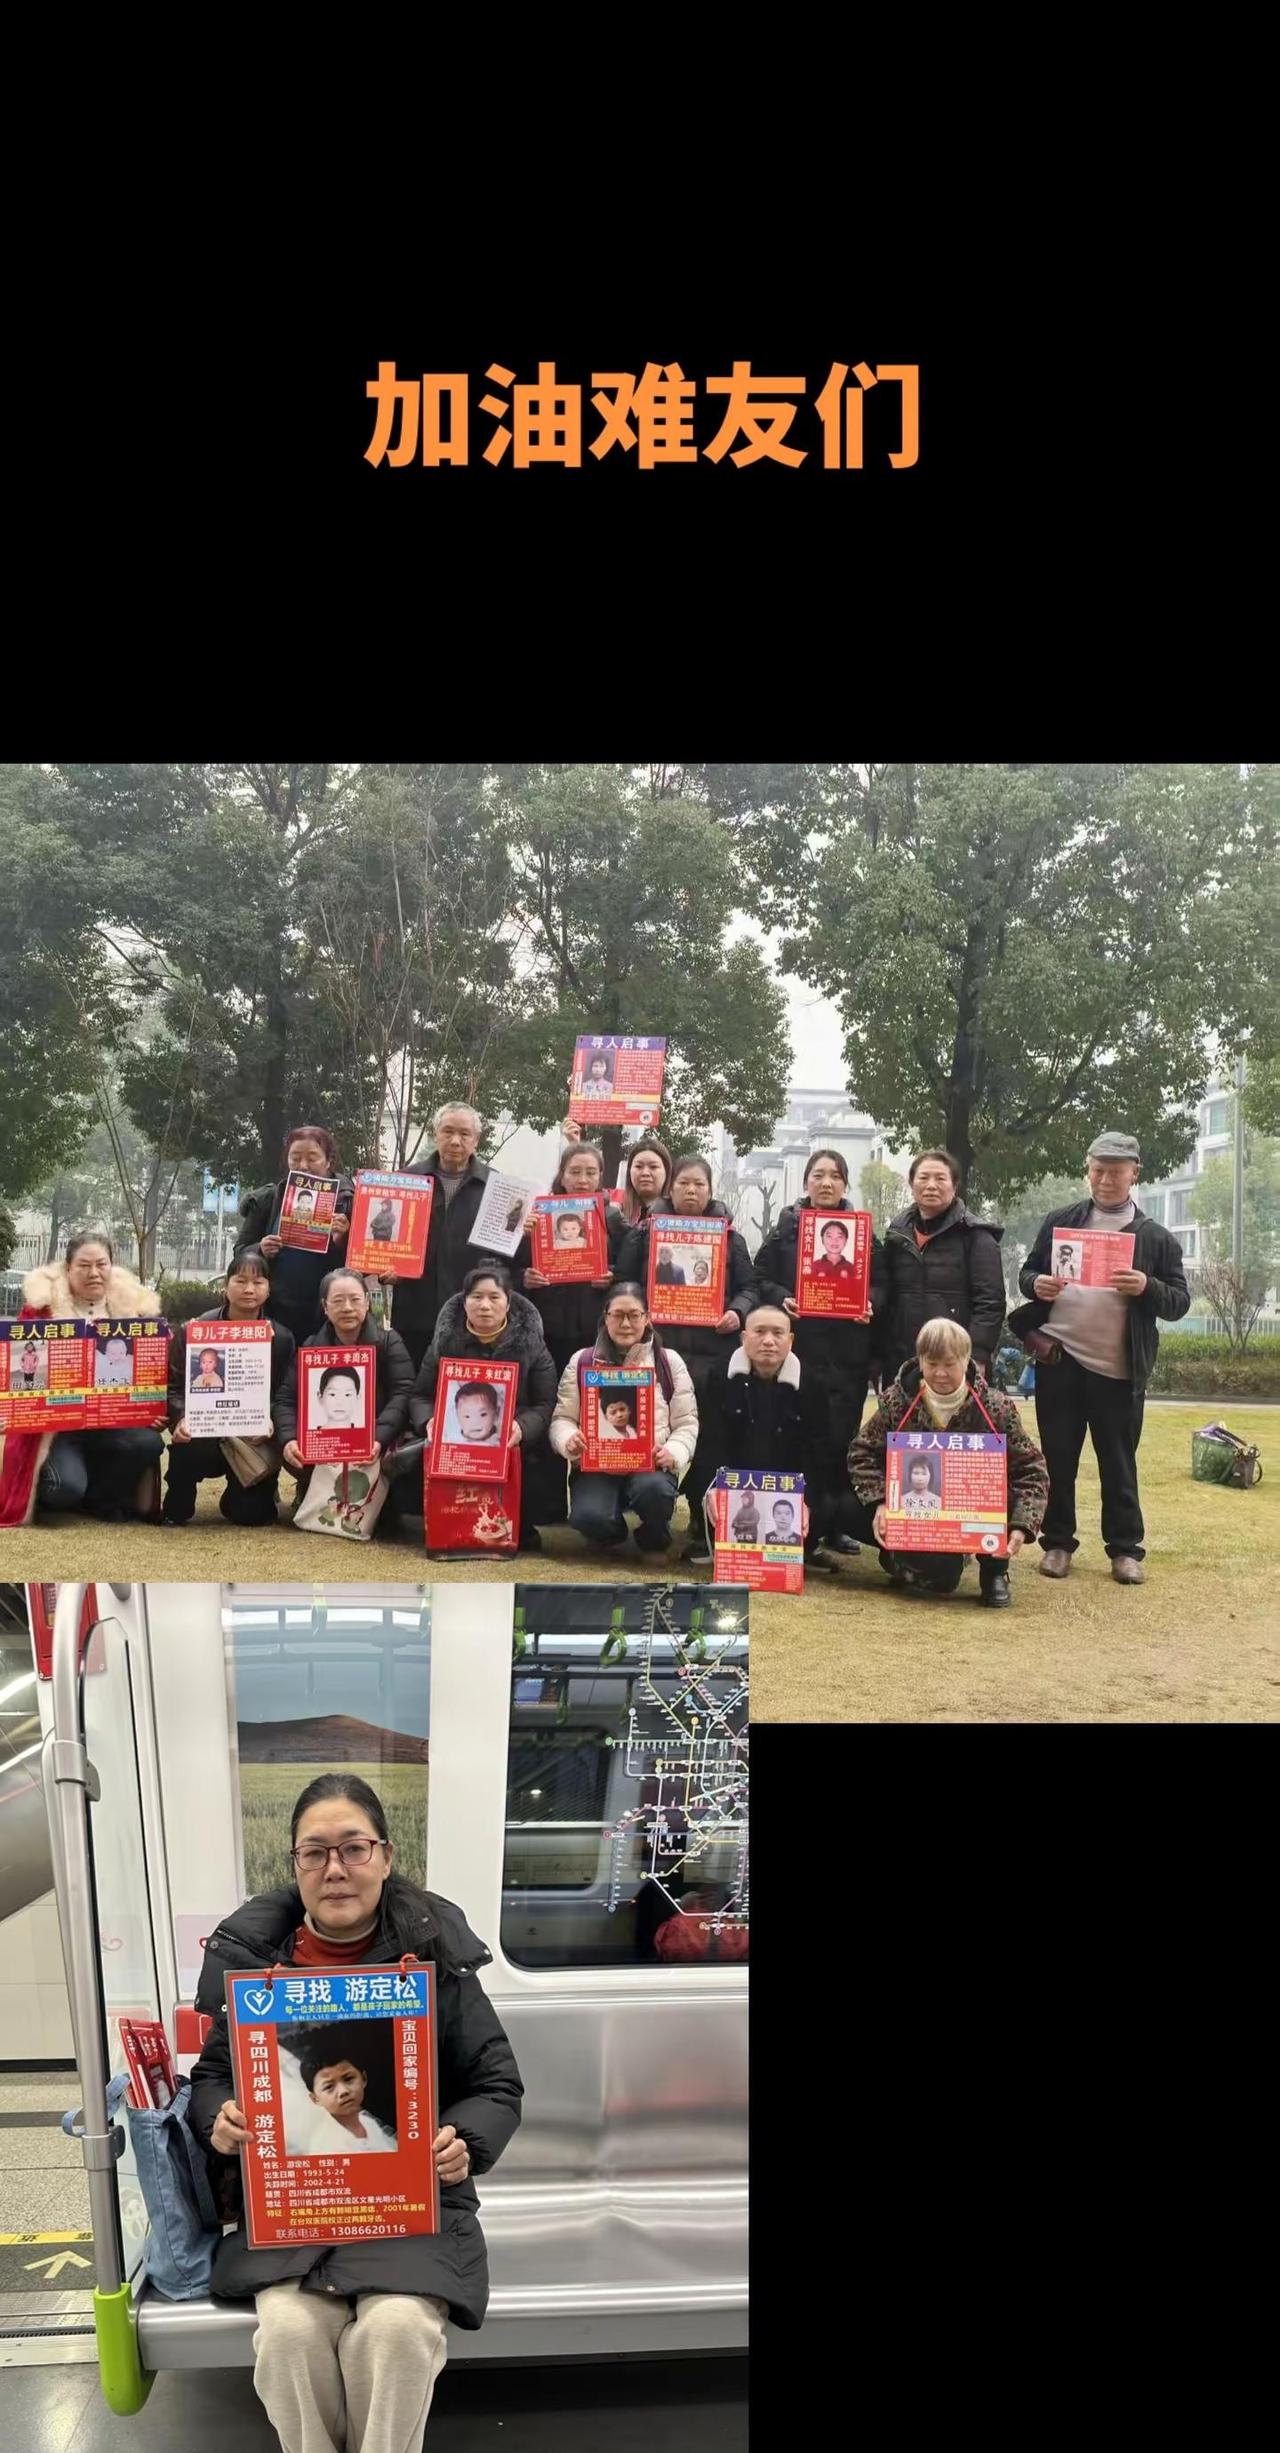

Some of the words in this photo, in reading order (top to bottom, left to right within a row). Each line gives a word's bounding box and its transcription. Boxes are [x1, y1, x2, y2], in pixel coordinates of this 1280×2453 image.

[592, 1037, 649, 1050] 寻人启事
[295, 1176, 332, 1191] 寻人启事
[803, 1216, 814, 1253] 寻找女儿
[9, 1323, 76, 1339] 寻人启事
[96, 1322, 160, 1337] 寻人启事
[191, 1326, 267, 1340] 寻儿子李继阳
[304, 1353, 339, 1365] 寻找儿子
[343, 1352, 370, 1364] 李周杰
[445, 1366, 481, 1379] 寻找儿子
[485, 1368, 512, 1381] 朱红波
[906, 1434, 986, 1451] 寻人启事
[725, 1472, 796, 1492] 寻人启事
[284, 1980, 332, 2004] 寻找
[345, 1977, 418, 2002] 游定松
[247, 2031, 273, 2103] 寻四川成都
[254, 2114, 278, 2159] 游定松
